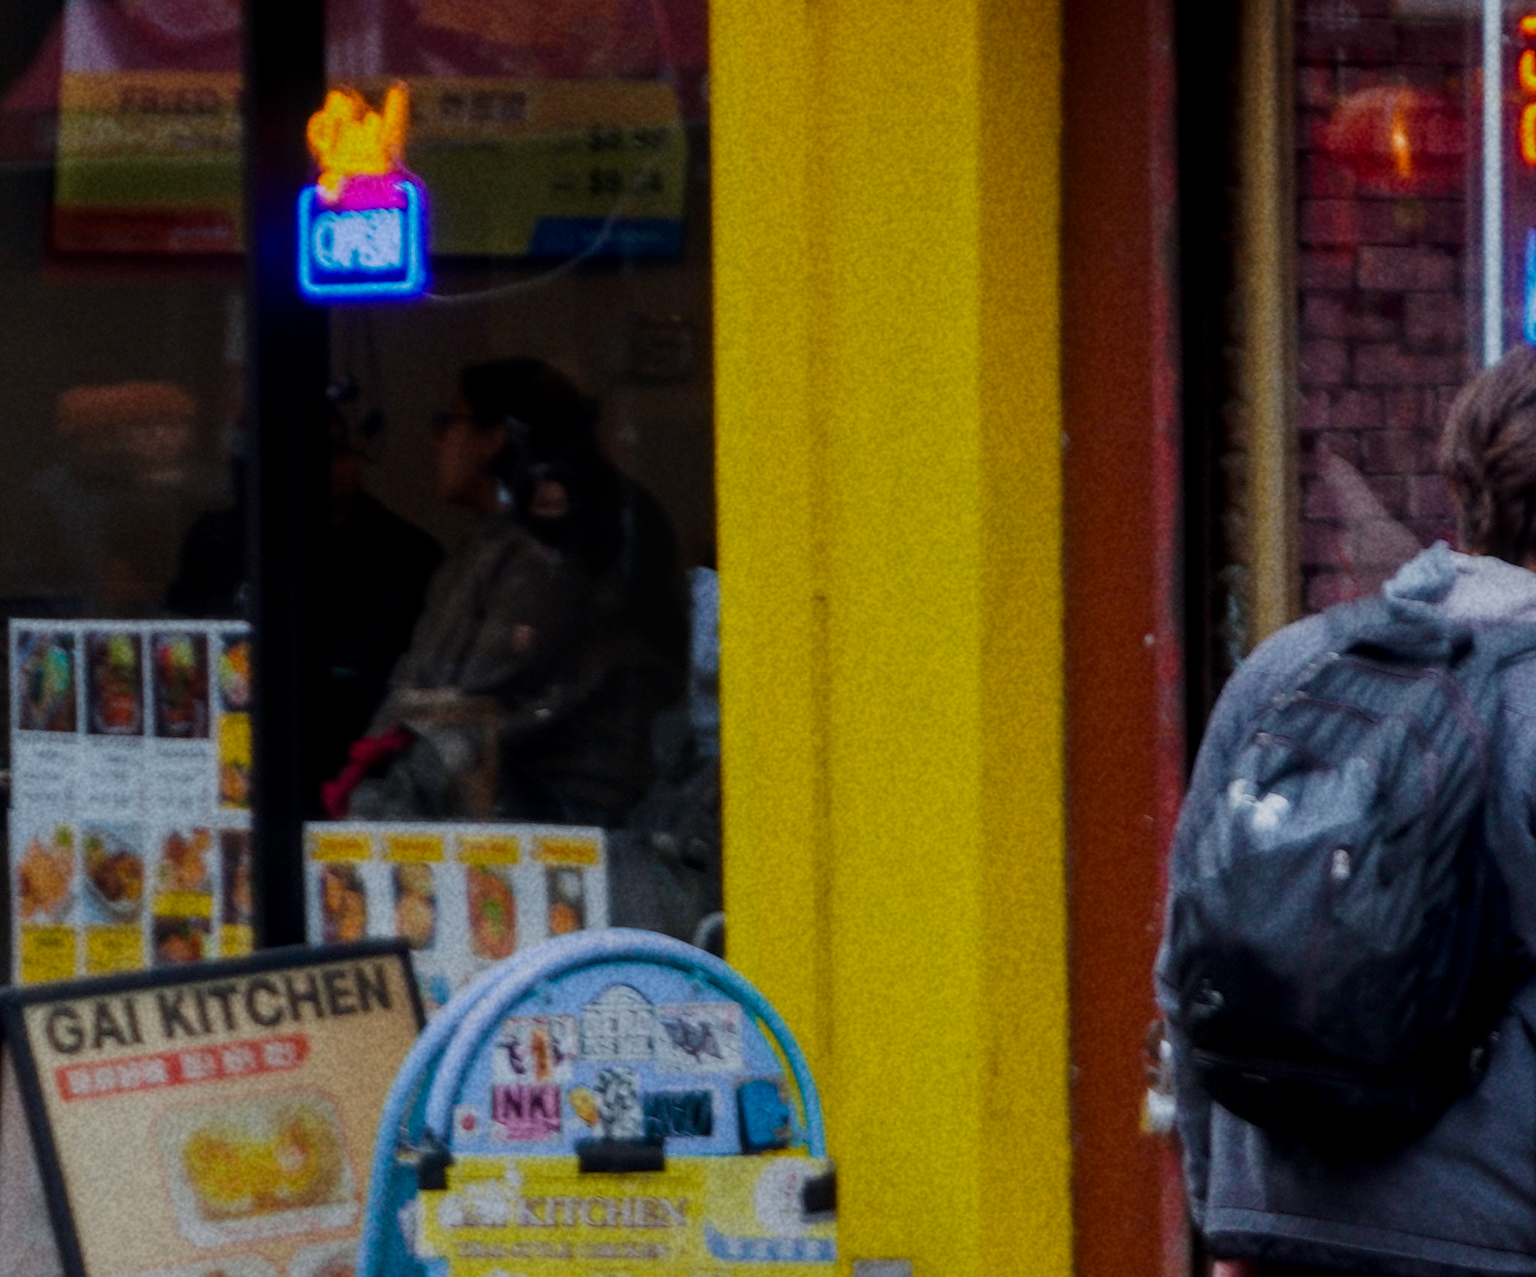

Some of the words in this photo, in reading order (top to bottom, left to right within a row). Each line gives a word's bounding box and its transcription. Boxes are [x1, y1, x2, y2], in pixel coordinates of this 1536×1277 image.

[45, 997, 143, 1055] GAI
[157, 964, 393, 1040] KITCHEN
[517, 1196, 688, 1229] KITCHEN
